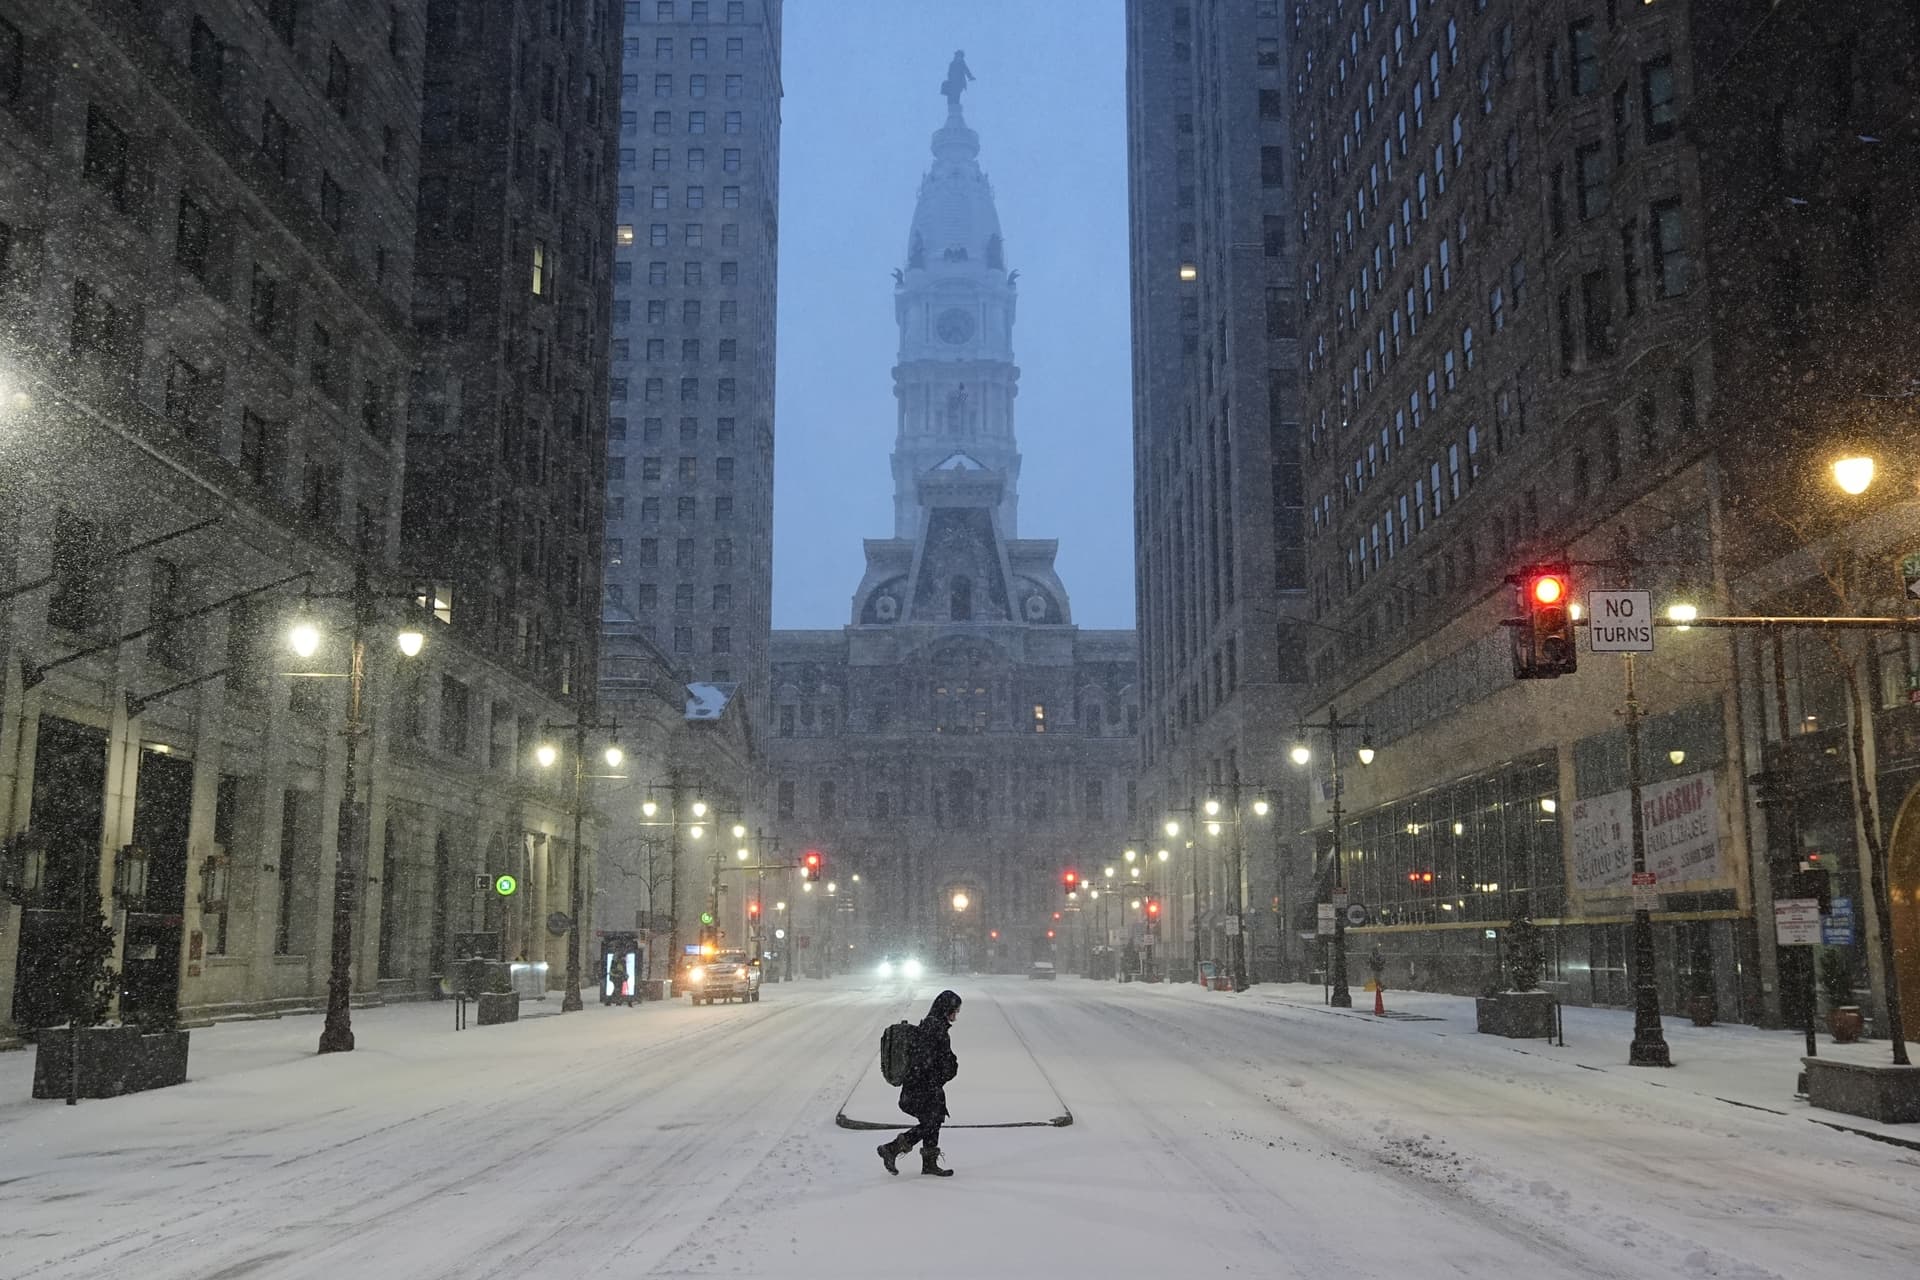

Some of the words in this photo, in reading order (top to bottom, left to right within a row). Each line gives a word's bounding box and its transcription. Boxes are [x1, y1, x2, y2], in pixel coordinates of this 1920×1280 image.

[1606, 599, 1634, 617] NO
[1594, 627, 1650, 643] TURNS
[1642, 777, 1704, 831] FLAGSHIP
[1670, 813, 1709, 846] LEASE
